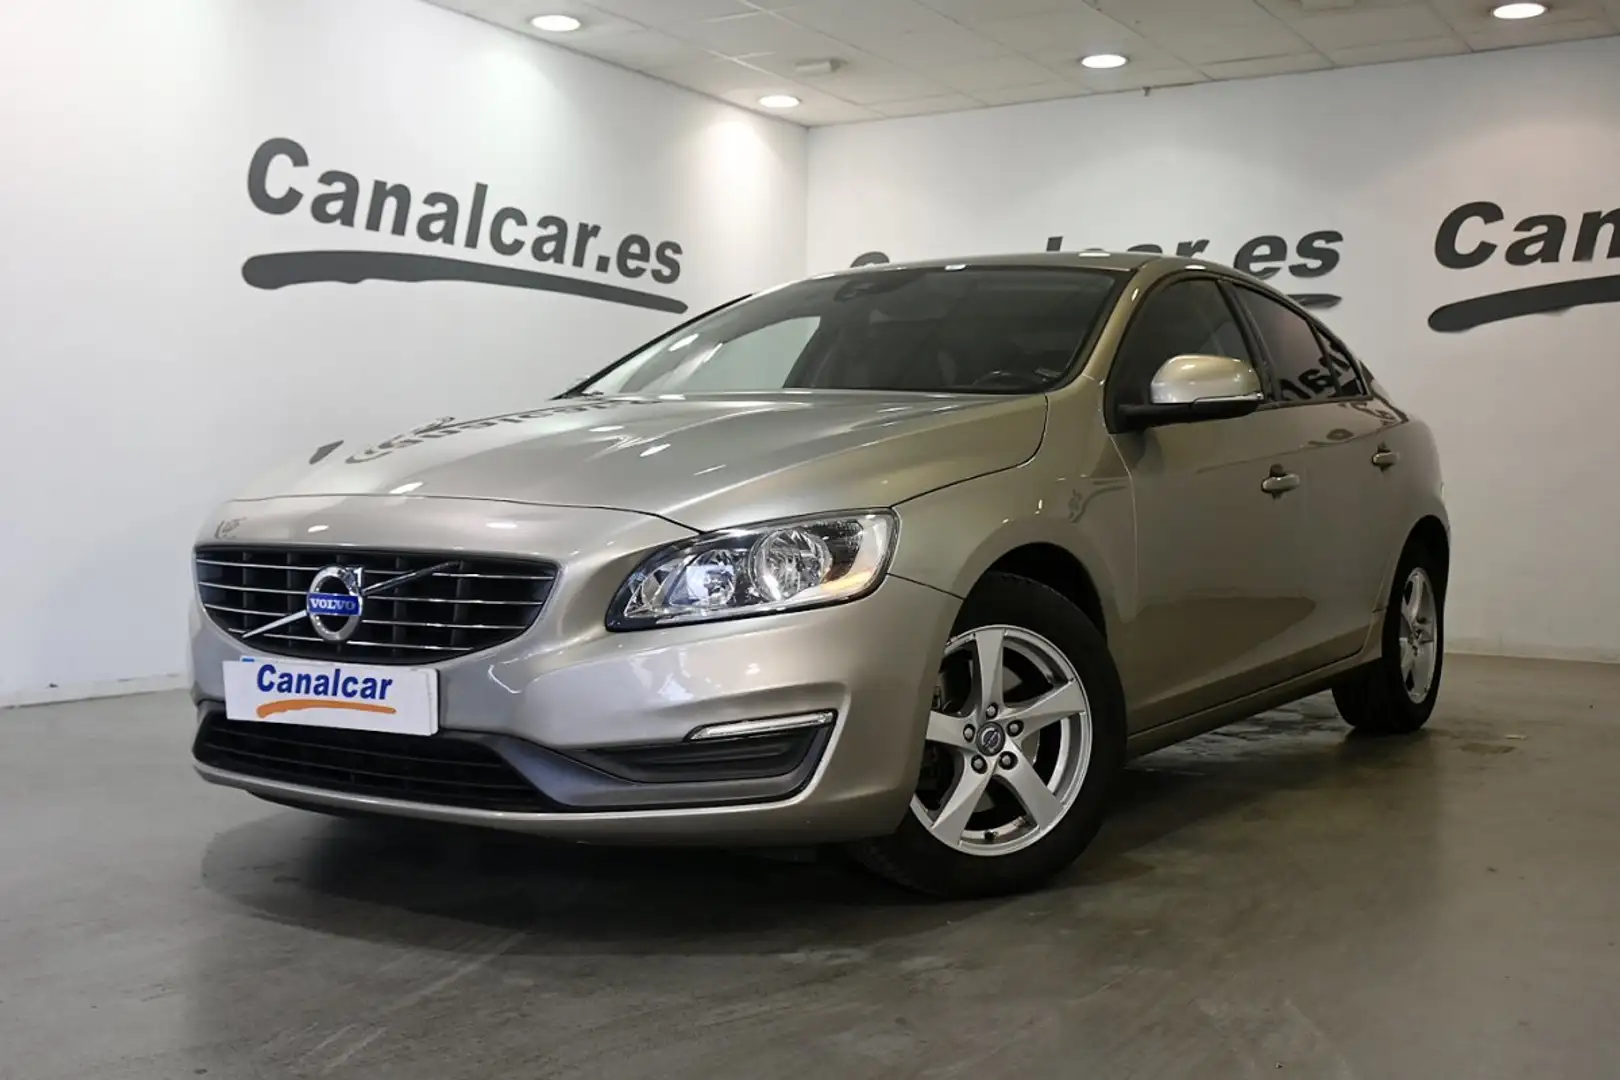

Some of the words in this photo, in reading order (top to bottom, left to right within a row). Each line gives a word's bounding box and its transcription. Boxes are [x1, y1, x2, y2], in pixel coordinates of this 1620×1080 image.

[247, 137, 684, 285] Canalcar.es
[310, 598, 356, 610] VOLVO
[256, 664, 393, 700] Canalcar
